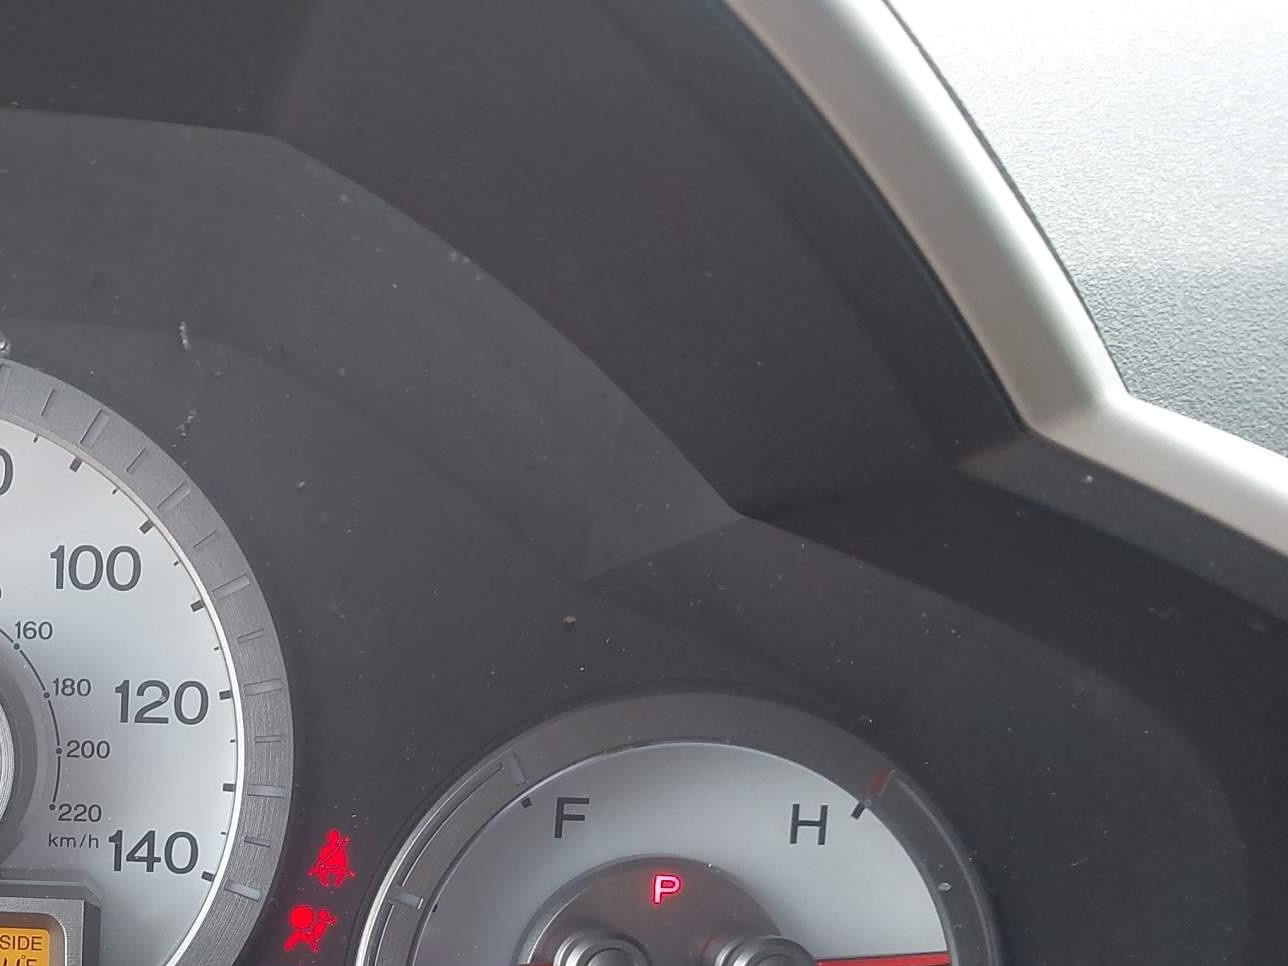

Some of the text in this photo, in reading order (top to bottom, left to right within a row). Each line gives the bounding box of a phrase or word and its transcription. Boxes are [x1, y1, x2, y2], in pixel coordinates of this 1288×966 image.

[50, 545, 142, 591] 100
[14, 620, 53, 640] 160
[52, 677, 92, 697] 180
[114, 679, 209, 725] 120
[66, 740, 110, 759] 200
[58, 803, 102, 823] 220
[554, 796, 590, 839] F
[789, 804, 829, 847] H
[48, 832, 99, 849] km/h
[108, 829, 199, 875] 140
[652, 874, 682, 904] P
